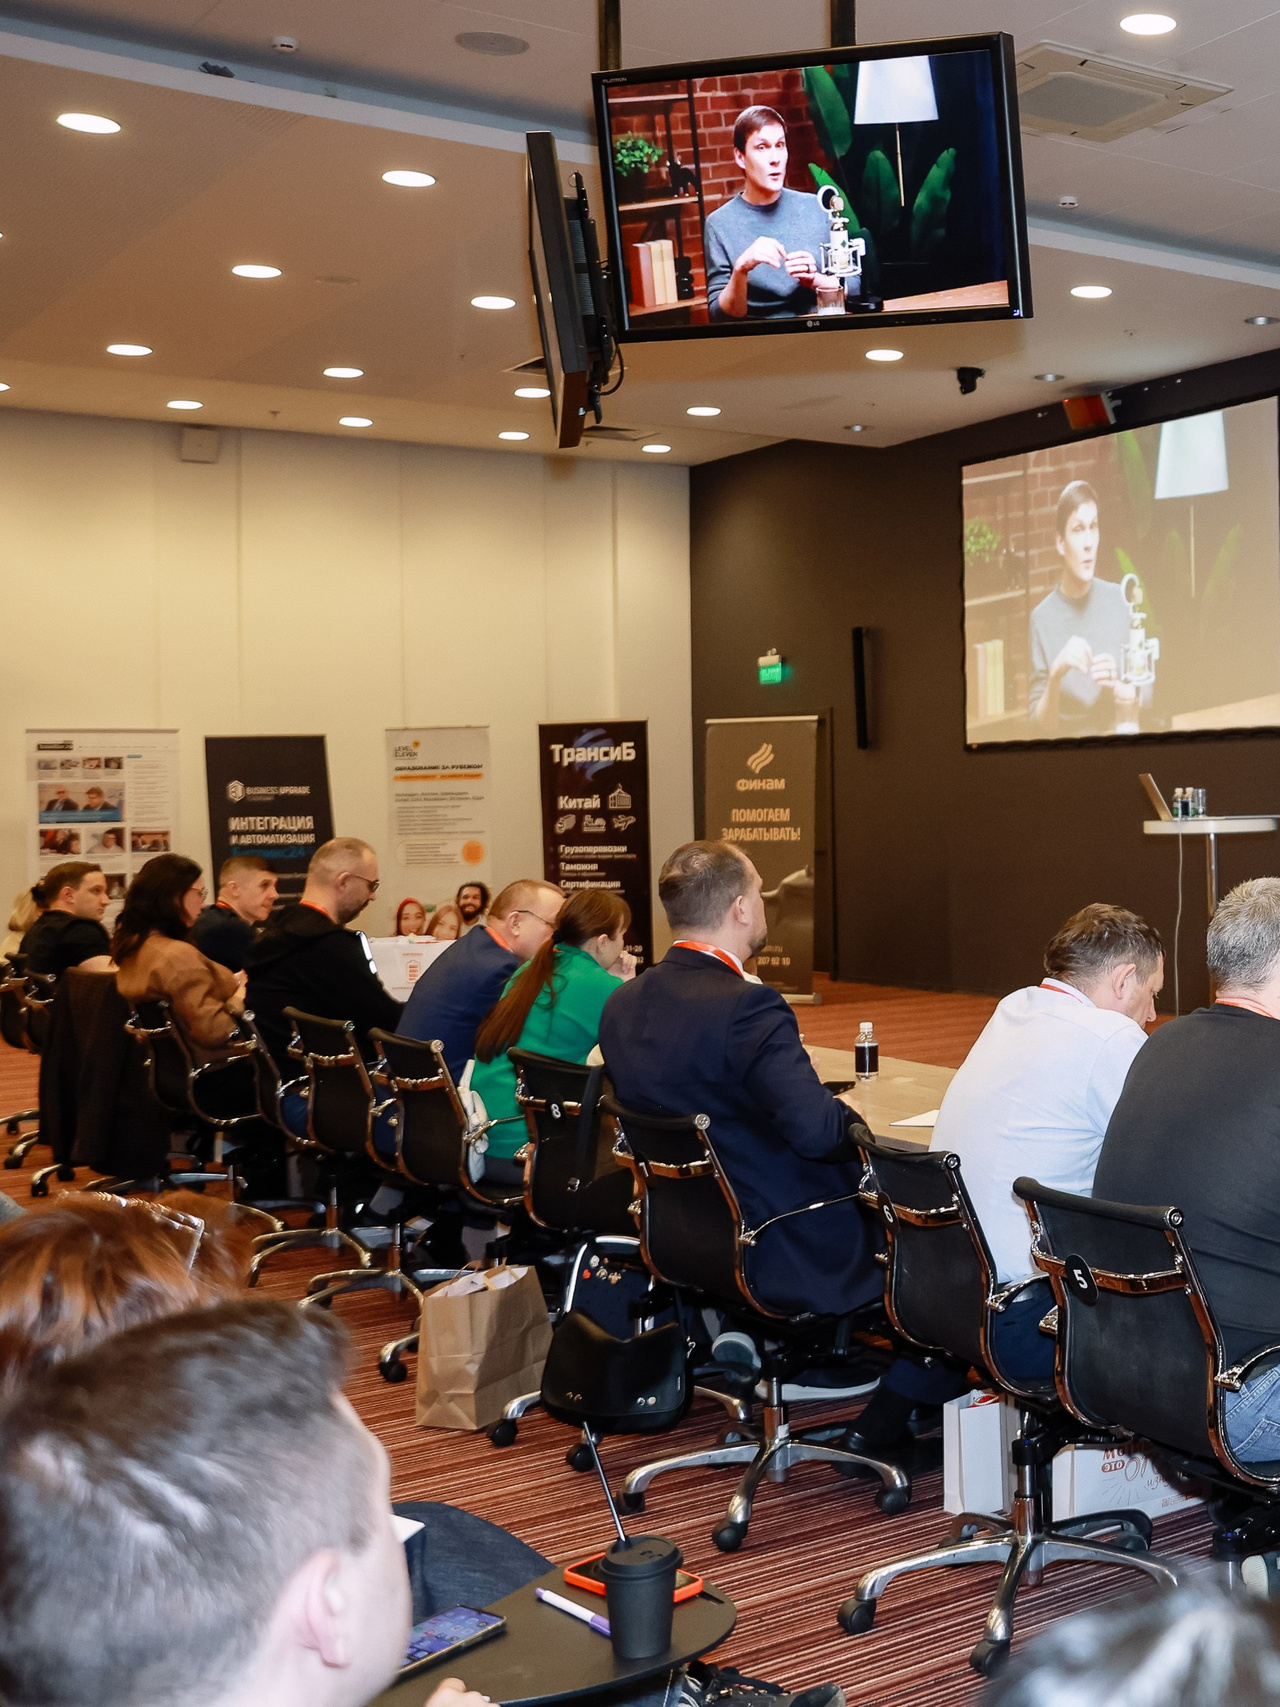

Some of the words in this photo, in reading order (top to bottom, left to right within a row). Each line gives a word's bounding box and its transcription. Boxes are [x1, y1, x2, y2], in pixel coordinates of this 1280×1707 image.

[559, 794, 601, 809] Китай
[731, 807, 791, 822] ПОМОГАЕМ
[228, 815, 314, 832] ИНТЕГРАЦИЯ
[240, 833, 316, 845] АВТОМАТИЗАЦИЯ
[721, 827, 801, 841] ЗАРАБАТЫВАТЬ!
[559, 844, 628, 854] Грузоперевозки
[559, 861, 599, 871] Таможня
[559, 880, 621, 890] Сертификация
[551, 1103, 561, 1119] 8
[883, 1204, 894, 1223] 6
[1072, 1269, 1088, 1289] 5
[1104, 1461, 1123, 1472] ЭТО
